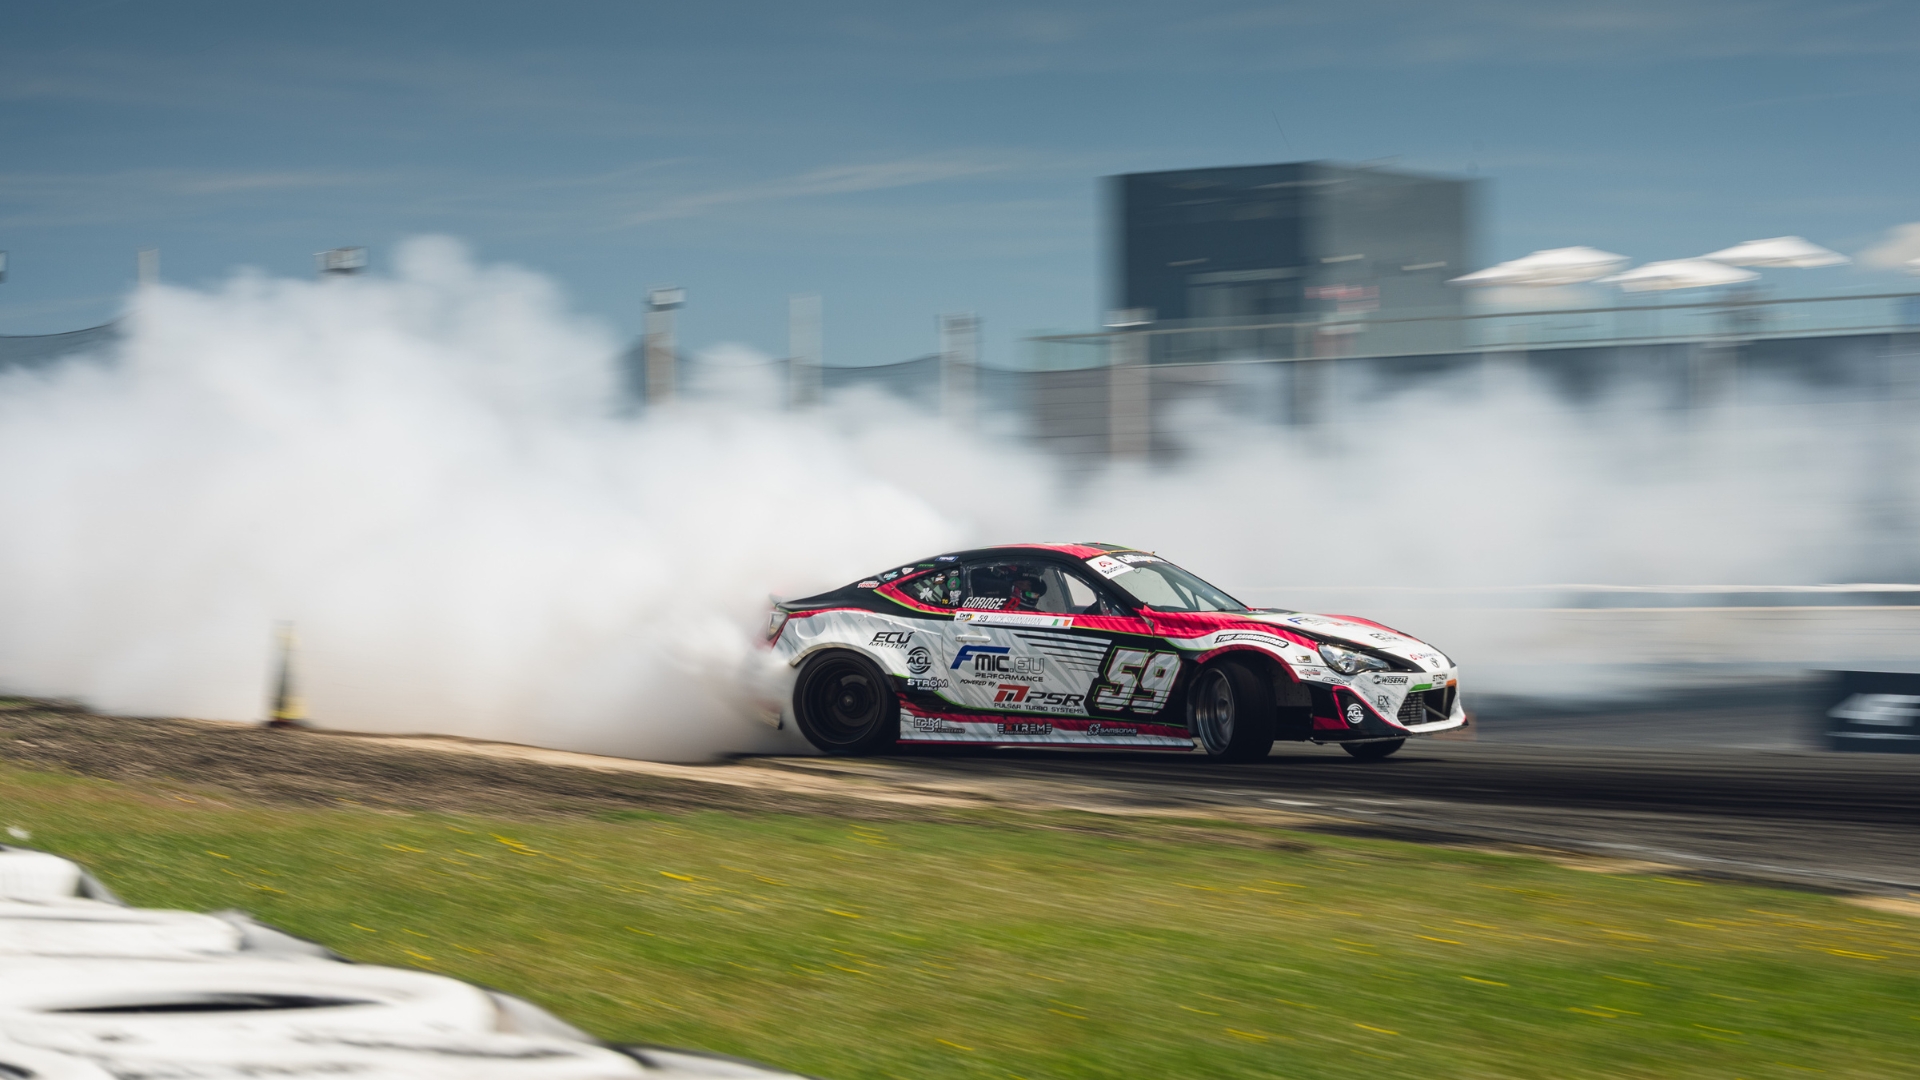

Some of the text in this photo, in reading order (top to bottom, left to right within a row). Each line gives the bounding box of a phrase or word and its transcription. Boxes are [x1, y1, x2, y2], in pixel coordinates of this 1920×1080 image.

[962, 597, 1007, 610] GARAGE
[978, 614, 989, 623] 59
[872, 631, 915, 644] ECU
[868, 641, 908, 650] MASTER
[906, 656, 932, 665] ACL
[975, 672, 1044, 682] PERFORMANCE
[1092, 646, 1182, 715] 59
[1381, 676, 1409, 684] WISEFAB
[1025, 691, 1085, 707] PSR
[1051, 706, 1084, 714] SYSTEMS
